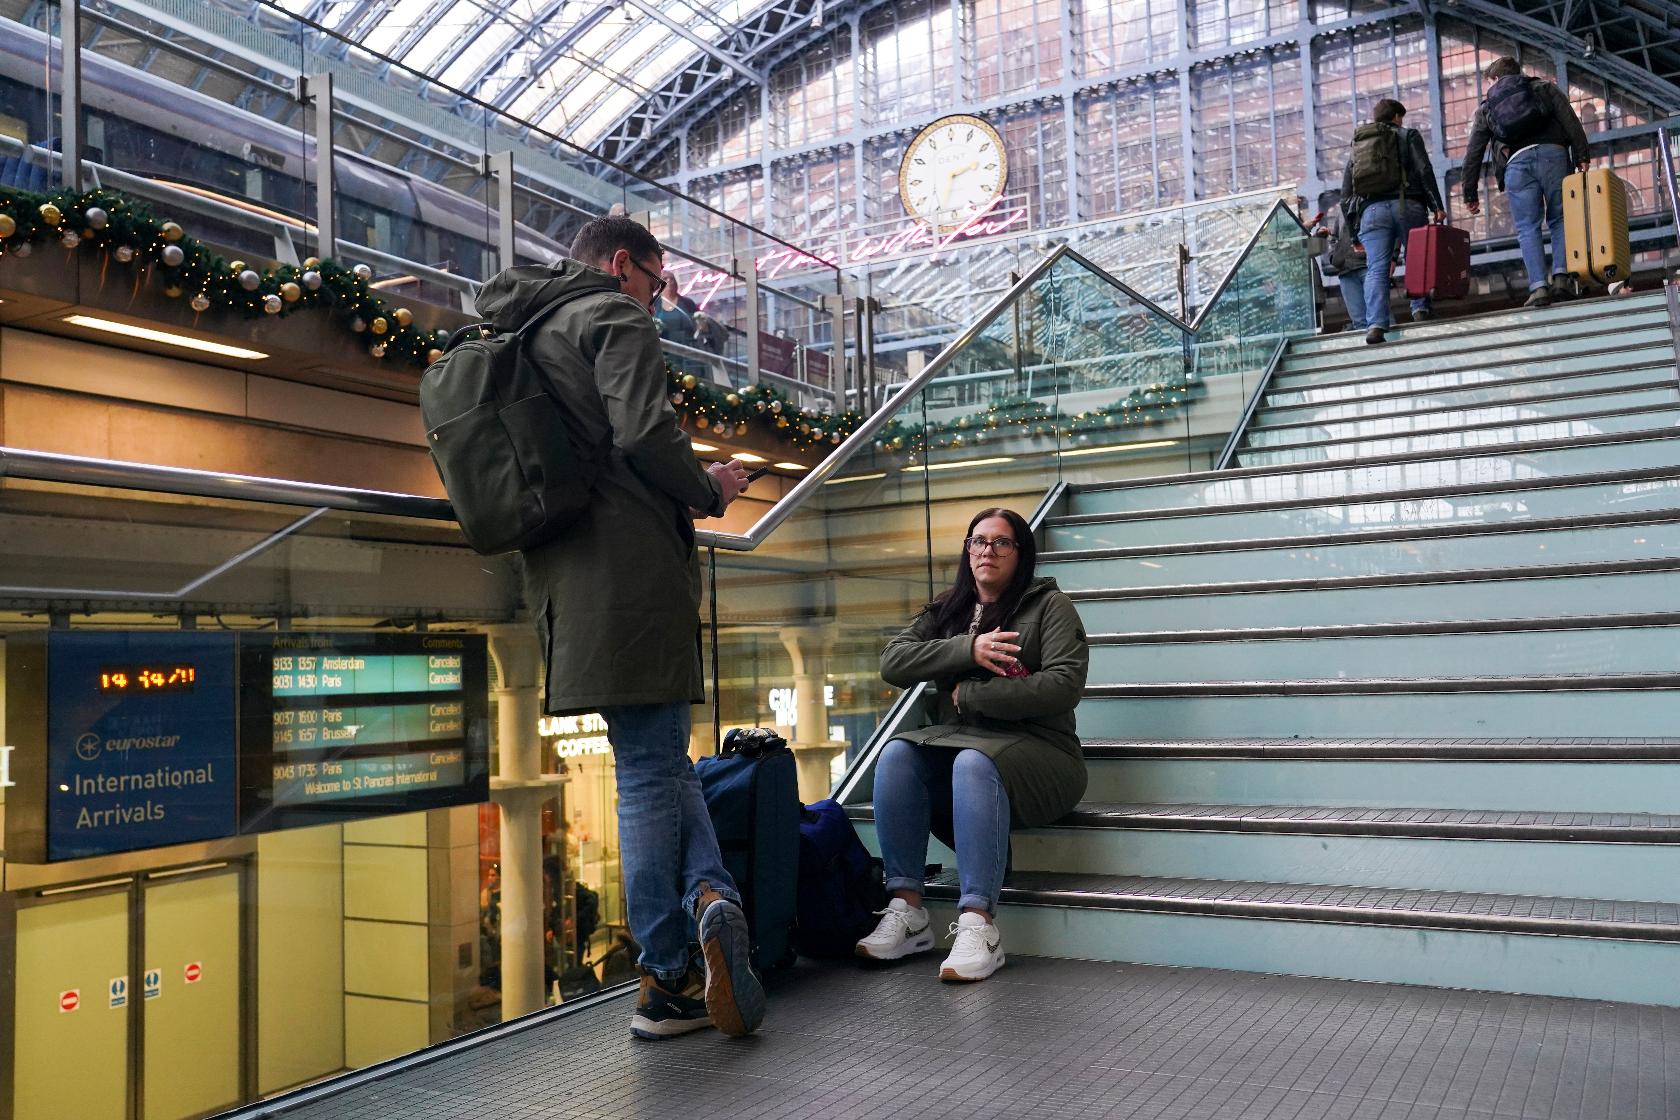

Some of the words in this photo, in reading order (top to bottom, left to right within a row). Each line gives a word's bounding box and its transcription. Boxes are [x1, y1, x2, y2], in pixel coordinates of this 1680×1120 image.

[322, 657, 365, 670] Amsterdam
[322, 674, 342, 687] Paris
[322, 709, 342, 722] Paris
[105, 735, 180, 752] eurostar
[557, 736, 610, 758] COFFEE
[322, 761, 342, 775] Paris
[75, 763, 214, 796] International
[304, 781, 340, 794] Welcome
[342, 779, 351, 791] to
[364, 776, 394, 788] Pancras
[396, 771, 438, 784] International
[76, 800, 165, 830] Arrivals
